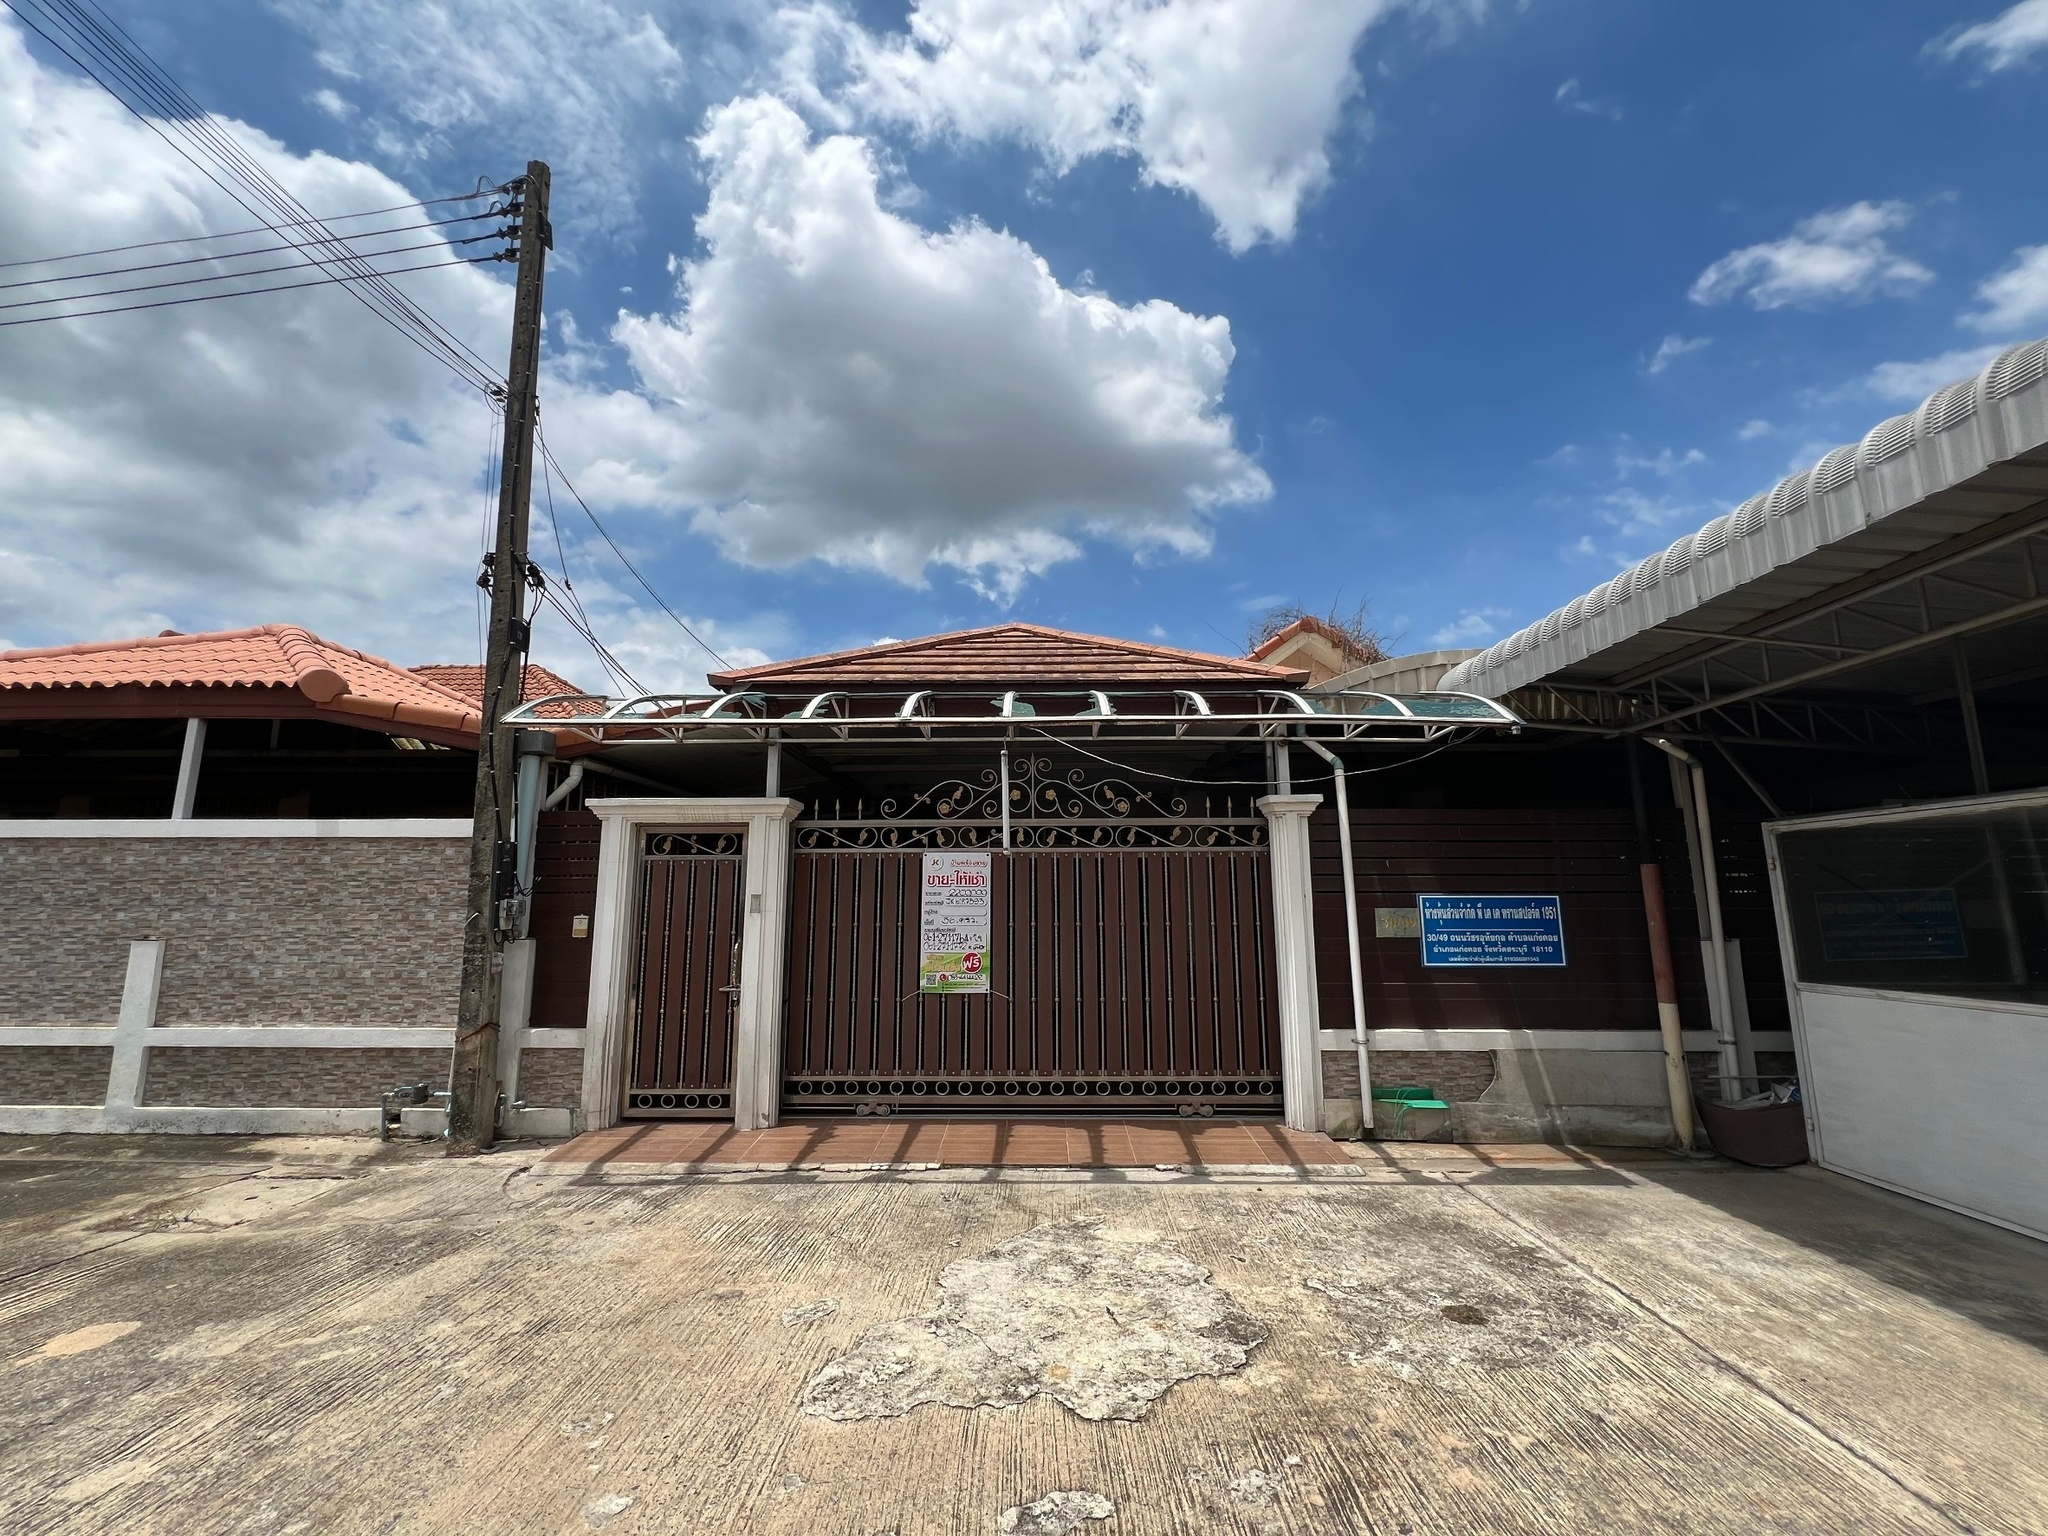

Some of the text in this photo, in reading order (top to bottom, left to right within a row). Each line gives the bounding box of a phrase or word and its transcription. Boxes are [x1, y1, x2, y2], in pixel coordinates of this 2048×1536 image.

[927, 869, 987, 887] ขาย-ให้เช่า
[1541, 906, 1557, 919] 1951
[1426, 933, 1448, 942] 30/49
[963, 955, 980, 969] ฟรี
